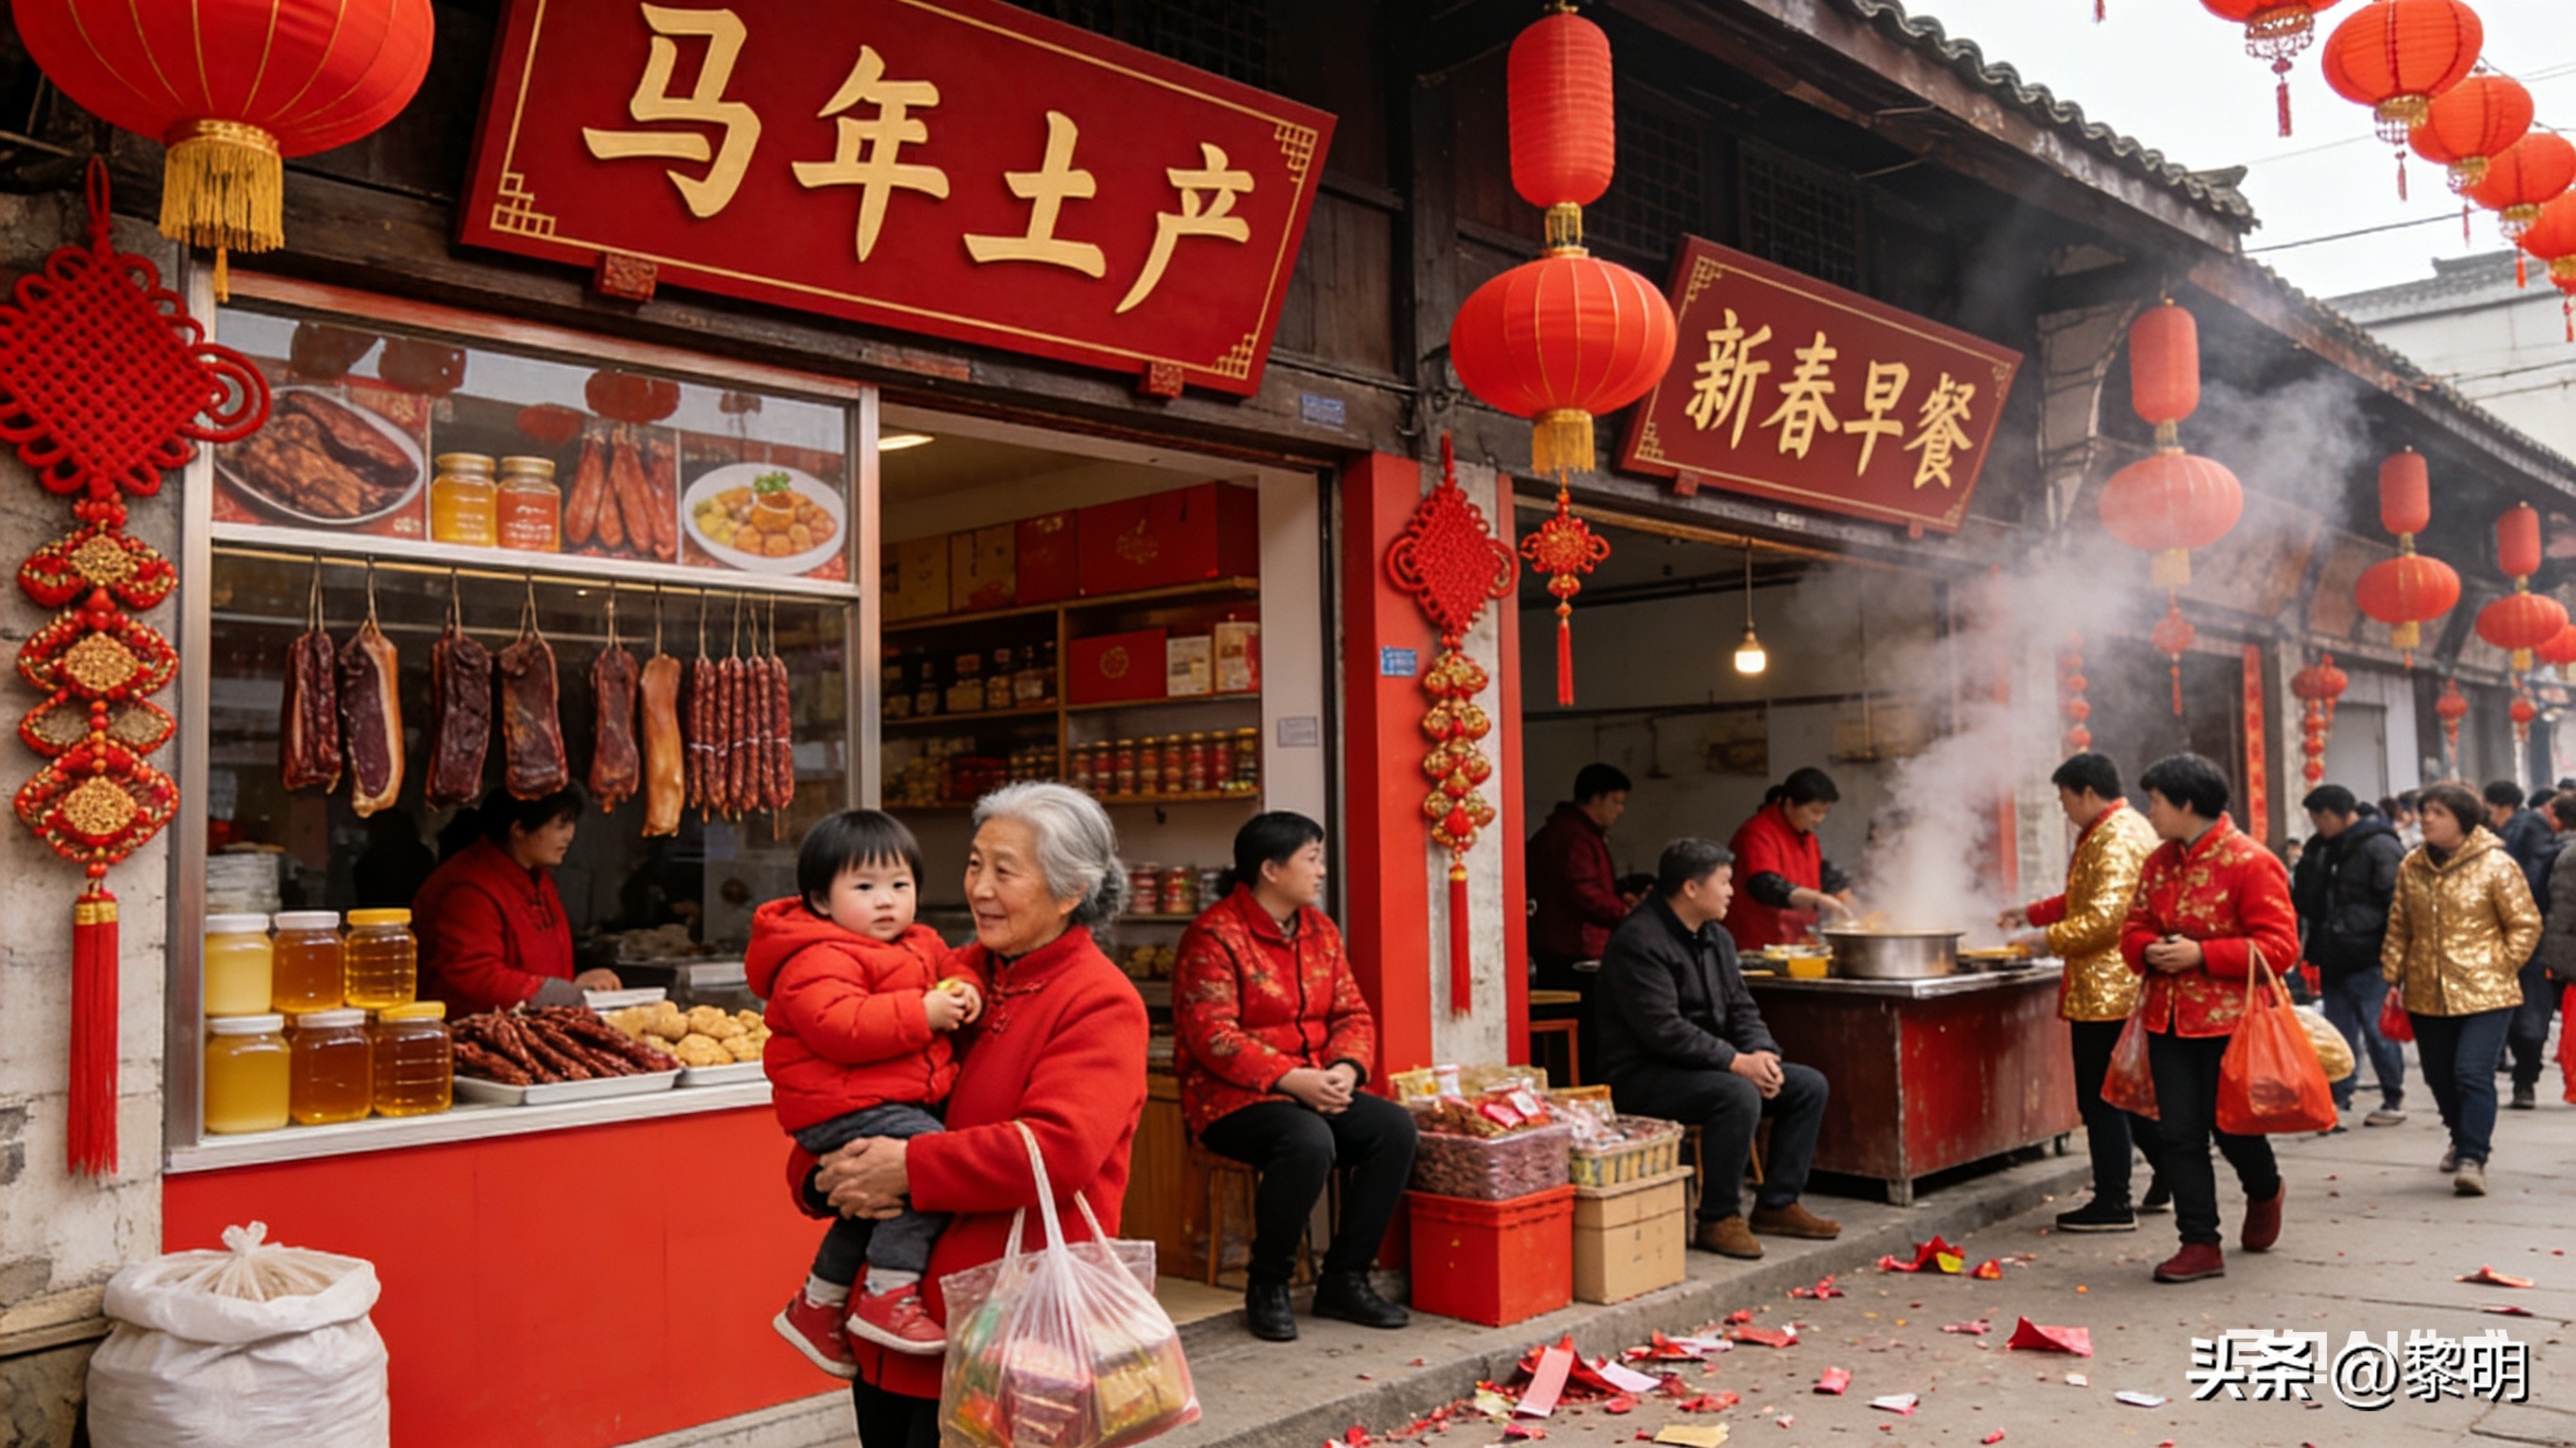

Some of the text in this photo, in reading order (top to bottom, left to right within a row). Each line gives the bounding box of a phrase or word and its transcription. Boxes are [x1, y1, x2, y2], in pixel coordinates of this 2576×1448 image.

[582, 2, 1255, 314] 马年土产
[1684, 308, 1977, 490] 新春早餐
